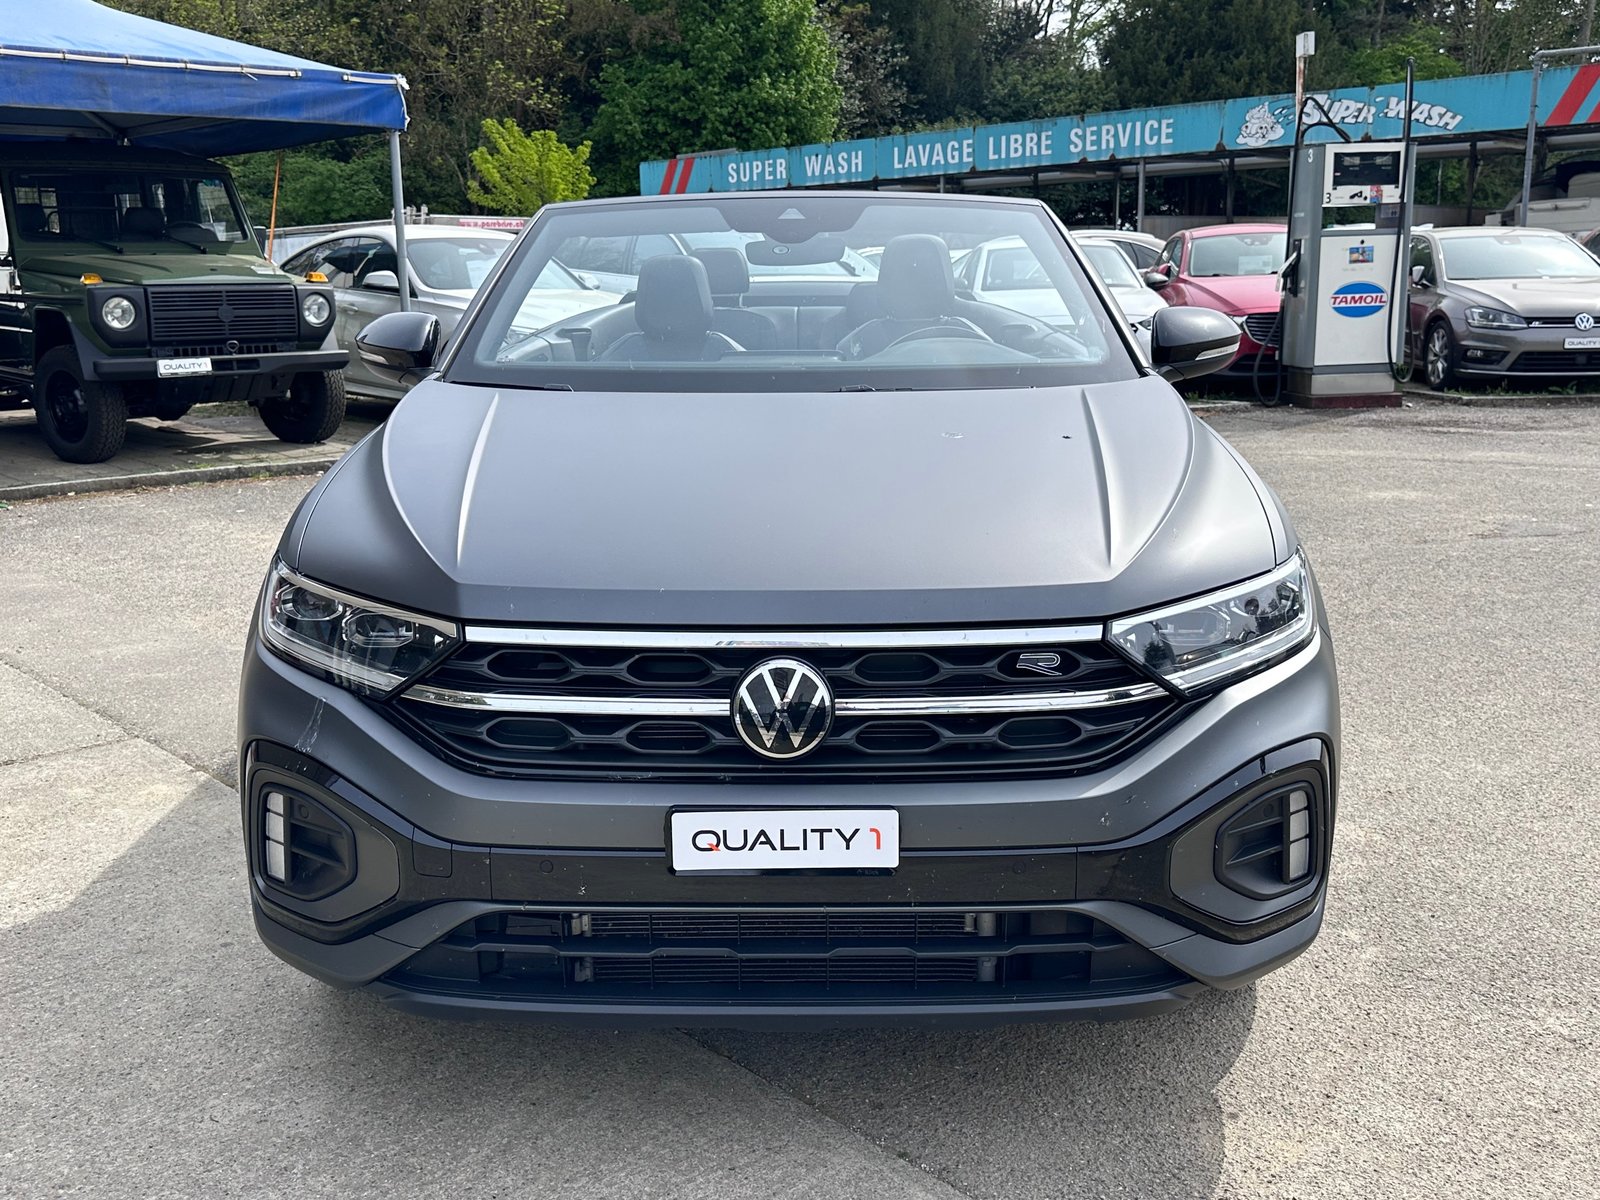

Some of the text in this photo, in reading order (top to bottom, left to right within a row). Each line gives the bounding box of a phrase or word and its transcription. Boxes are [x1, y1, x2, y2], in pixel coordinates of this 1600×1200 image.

[1302, 94, 1463, 131] SUPER WASH
[728, 118, 1174, 183] SUPER WASH LAVAGE LIBRE SERVICE
[1307, 148, 1314, 163] 3
[1325, 192, 1332, 204] 3
[1330, 294, 1387, 306] TAMOIL
[163, 362, 202, 371] QUALITY
[1016, 652, 1063, 676] R
[691, 827, 881, 852] QUALITY 1
